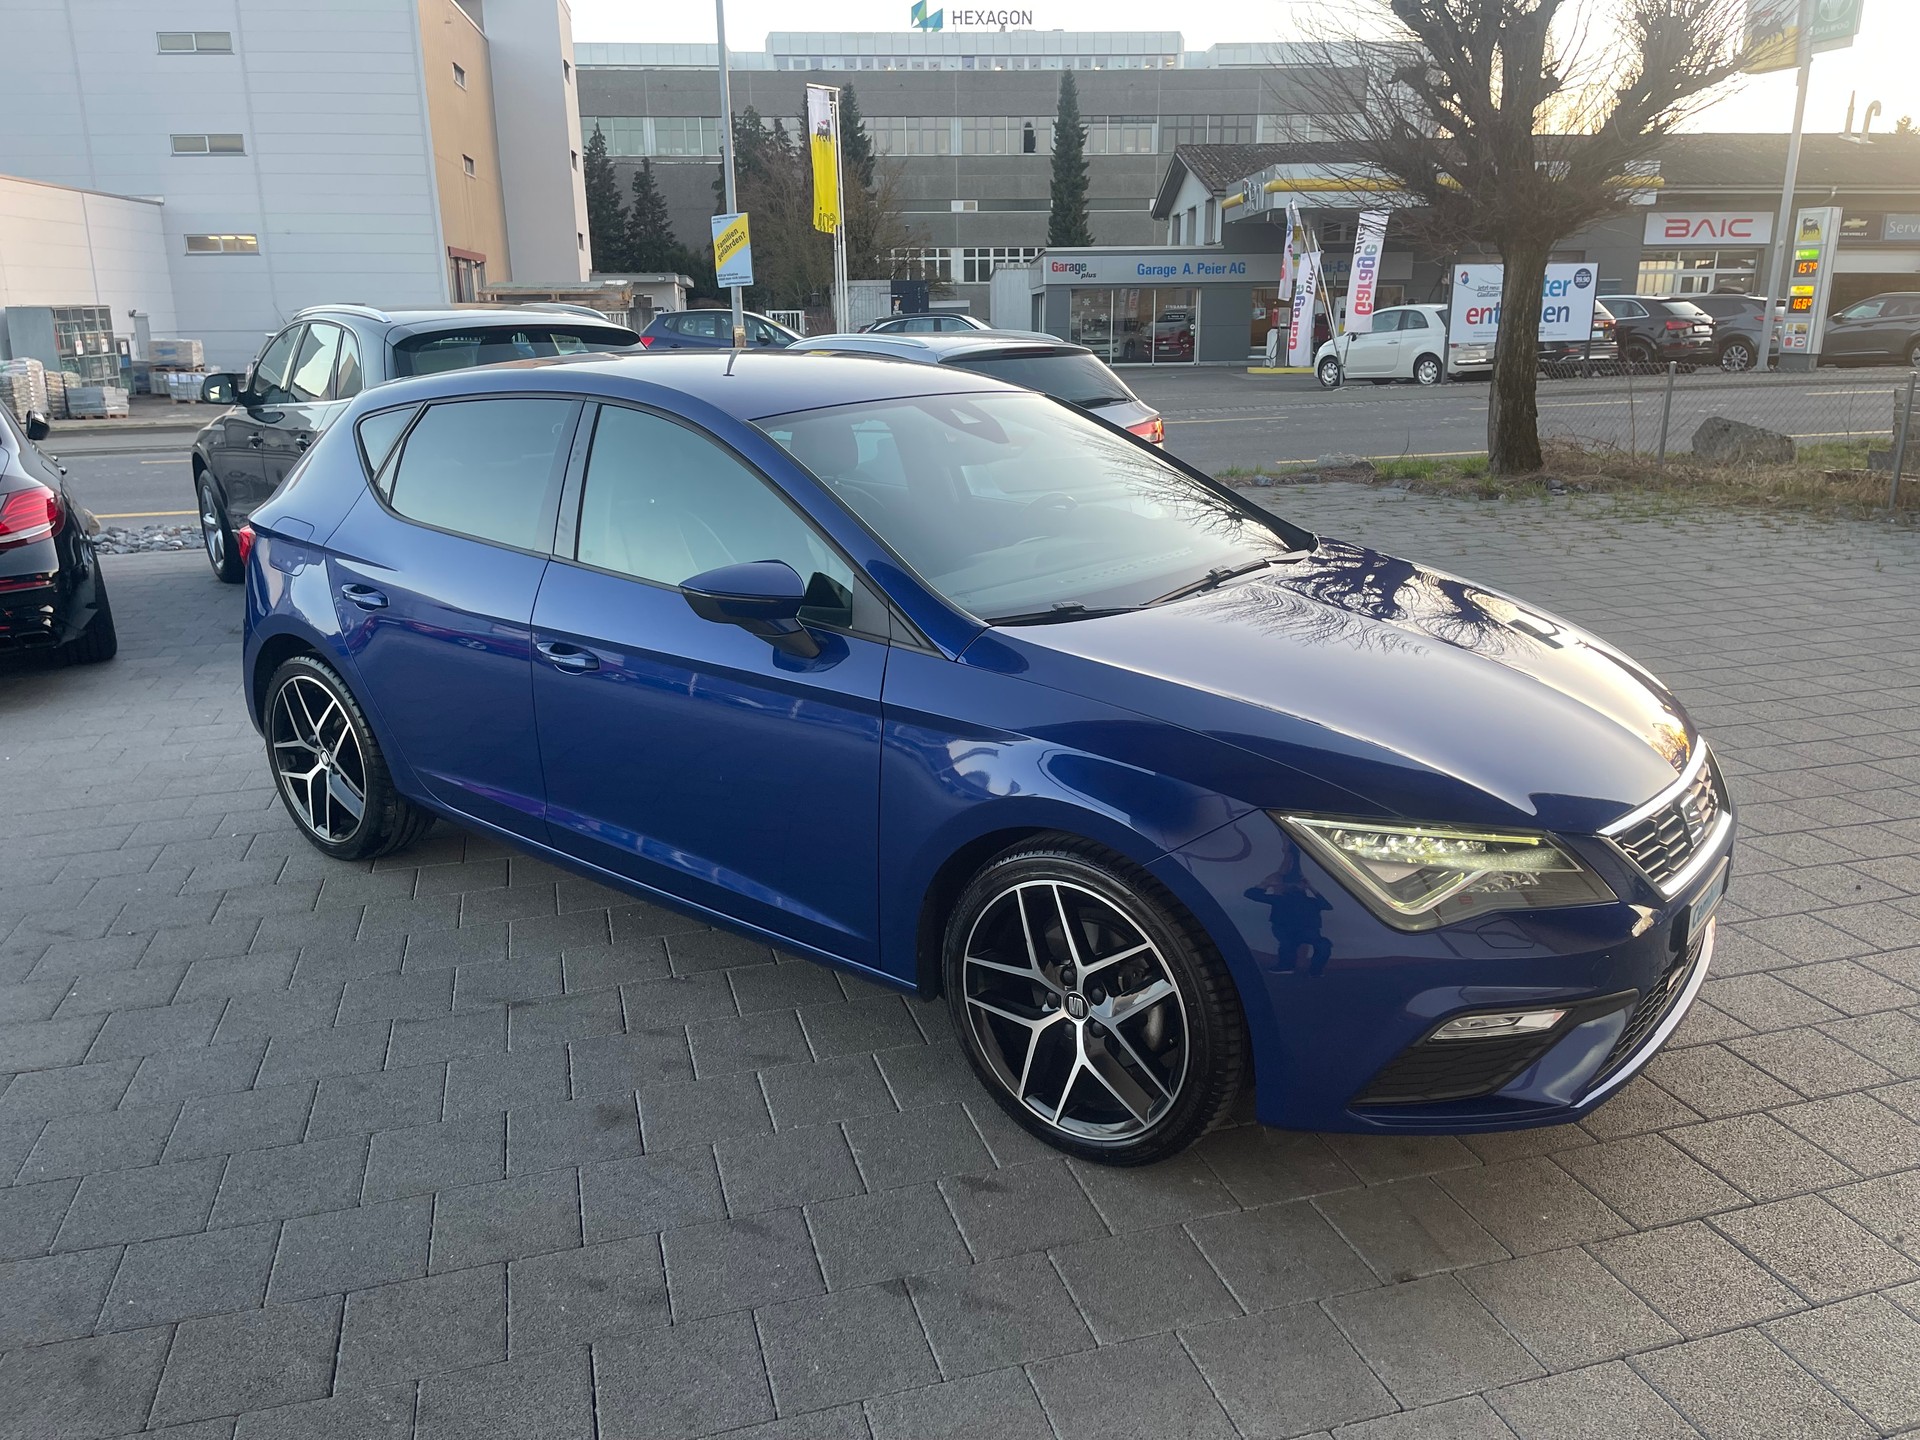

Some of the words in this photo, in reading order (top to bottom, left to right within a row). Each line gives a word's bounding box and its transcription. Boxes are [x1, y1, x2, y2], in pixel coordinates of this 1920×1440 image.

[952, 10, 1033, 25] HEXAGON
[1664, 218, 1754, 238] BAIC
[716, 228, 739, 251] Familien
[717, 231, 746, 262] gefährden?
[1051, 261, 1087, 275] Garage
[1080, 271, 1097, 279] plus
[1137, 263, 1177, 278] Garage
[1182, 263, 1194, 275] A.
[1197, 262, 1227, 275] Peier
[1229, 262, 1246, 275] AG
